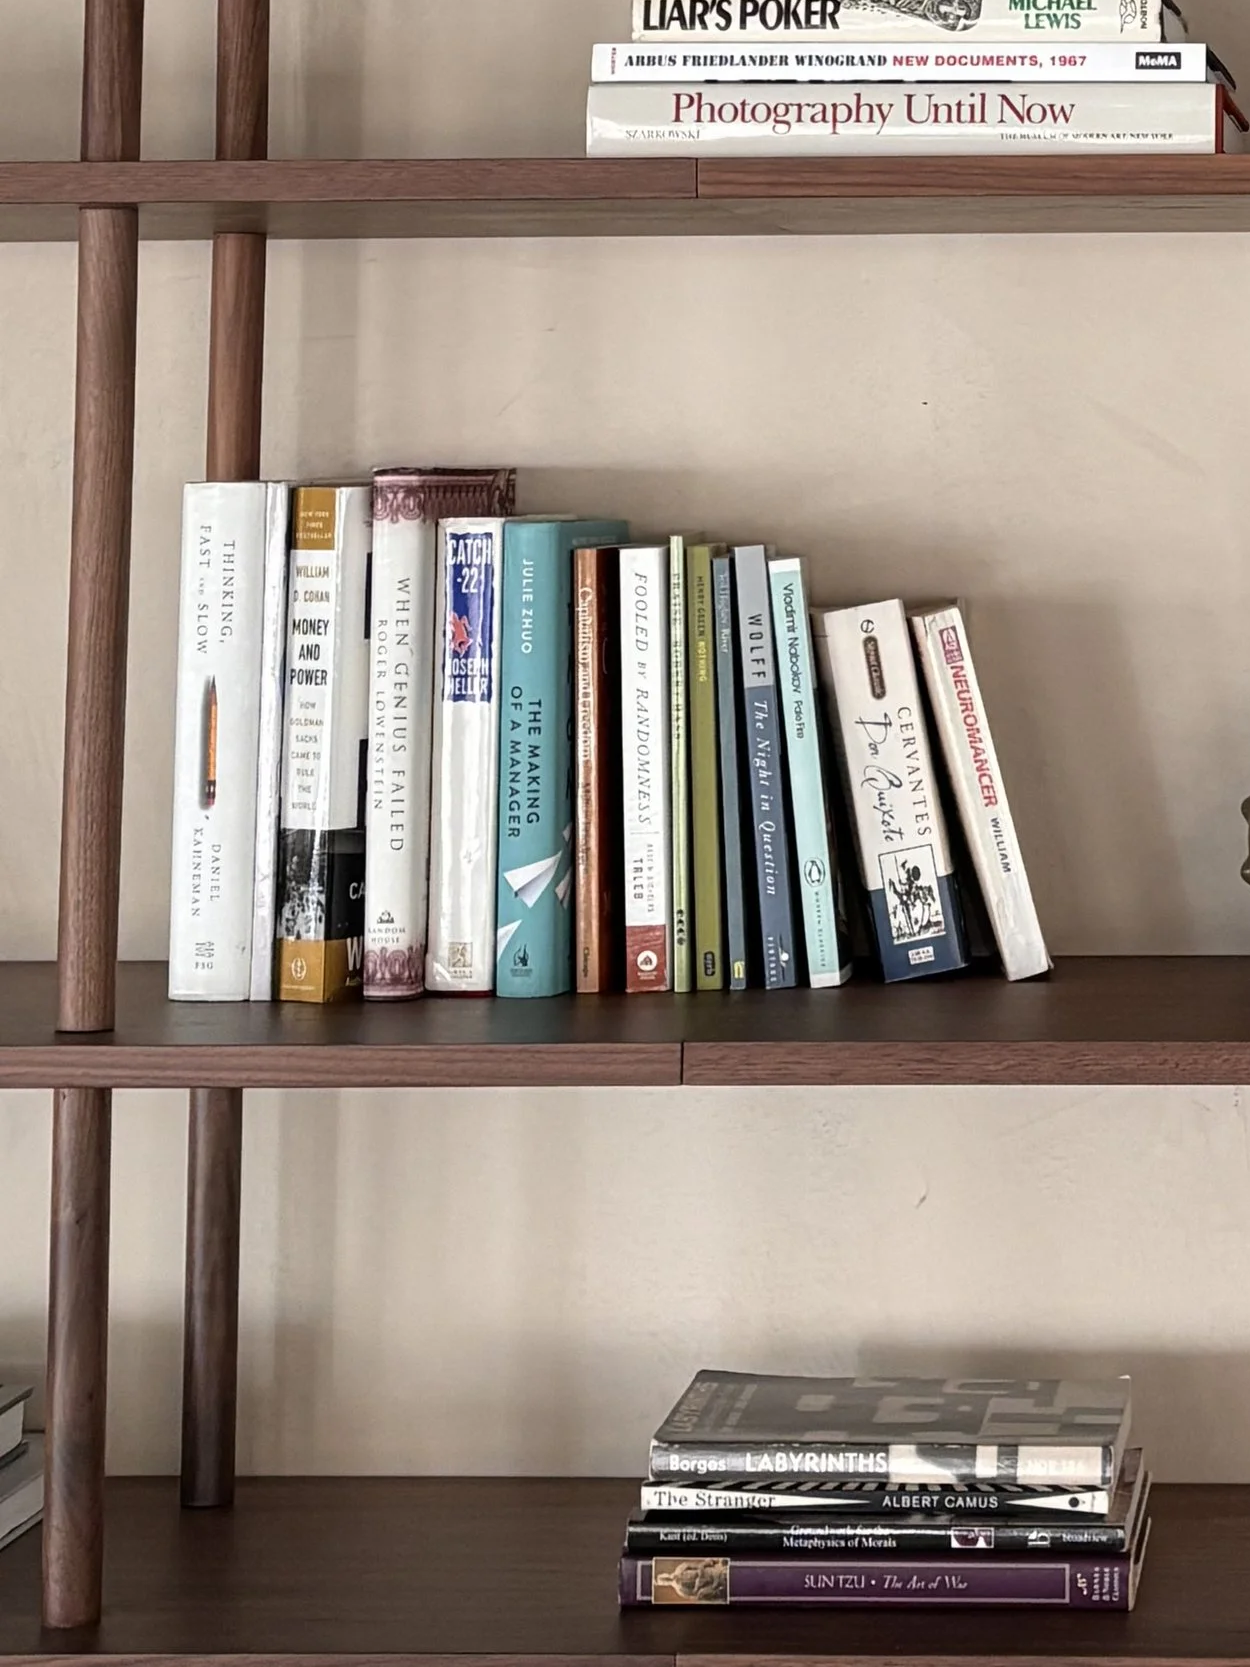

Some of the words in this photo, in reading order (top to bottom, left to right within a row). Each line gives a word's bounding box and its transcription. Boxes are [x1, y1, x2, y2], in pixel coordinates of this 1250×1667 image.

[1024, 13, 1082, 30] LEWIS
[624, 55, 677, 67] ARBUS
[682, 54, 789, 67] FRIEDLANDER
[795, 54, 887, 67] WINOGRAND
[892, 55, 929, 66] NEW
[935, 55, 1043, 69] DOCUMENTS,
[1050, 55, 1087, 66] 1967
[1138, 55, 1177, 67] MoMA
[672, 92, 895, 135] Photography
[904, 92, 987, 125] Until
[997, 93, 1076, 125] Now
[199, 525, 212, 568] FAST
[449, 538, 492, 565] CATCH
[220, 540, 236, 644] THINKING,
[295, 566, 330, 578] WILLIAM
[456, 567, 479, 593] -22
[522, 559, 534, 602] JULIE
[303, 590, 330, 602] COHAN
[396, 578, 410, 645] WHEN
[634, 572, 649, 652] FOOLED
[783, 583, 798, 633] Vladimir
[196, 603, 209, 655] SLOW
[292, 618, 330, 635] MONEY
[521, 609, 533, 654] ZHUO
[748, 613, 766, 678] WOLFF
[299, 644, 321, 661] AND
[376, 620, 388, 678] ROGER
[449, 658, 489, 675] OSEH
[637, 662, 646, 679] BY
[788, 637, 802, 694] Nabokov
[290, 668, 328, 686] POWER
[448, 677, 488, 695] HELLR
[511, 686, 523, 711] OF
[392, 663, 409, 753] GENIUS
[510, 719, 522, 731] A
[528, 699, 542, 736] THE
[754, 700, 769, 729] The
[374, 691, 386, 810] LOWENSTEIN
[855, 712, 892, 757] Don
[636, 688, 652, 825] RANDOMNESS
[753, 734, 771, 784] Night
[897, 706, 932, 836] CERVANTES
[950, 665, 998, 808] NEUROMANCER
[990, 817, 1011, 873] WILLIAM
[508, 740, 523, 838] MANAGER
[527, 744, 541, 824] MAKING
[761, 791, 771, 811] in
[390, 770, 406, 851] FAILED
[192, 827, 203, 917] KAHNEMAN
[210, 843, 222, 902] DANIEL
[634, 858, 644, 900] TALEB
[759, 820, 778, 895] Question
[670, 1455, 726, 1474] Borges
[746, 1452, 888, 1473] LABYRINTHS
[654, 1491, 688, 1508] The
[695, 1491, 776, 1509] Stranger
[882, 1495, 940, 1508] ALBERT
[945, 1495, 998, 1508] CAMUS
[783, 1537, 846, 1549] Metaphysics
[848, 1537, 859, 1547] of
[861, 1537, 897, 1547] Morals
[804, 1575, 834, 1589] SUN
[838, 1575, 865, 1588] TZU
[883, 1575, 903, 1589] The
[906, 1575, 927, 1589] Art
[929, 1576, 941, 1590] of
[945, 1575, 968, 1589] War
